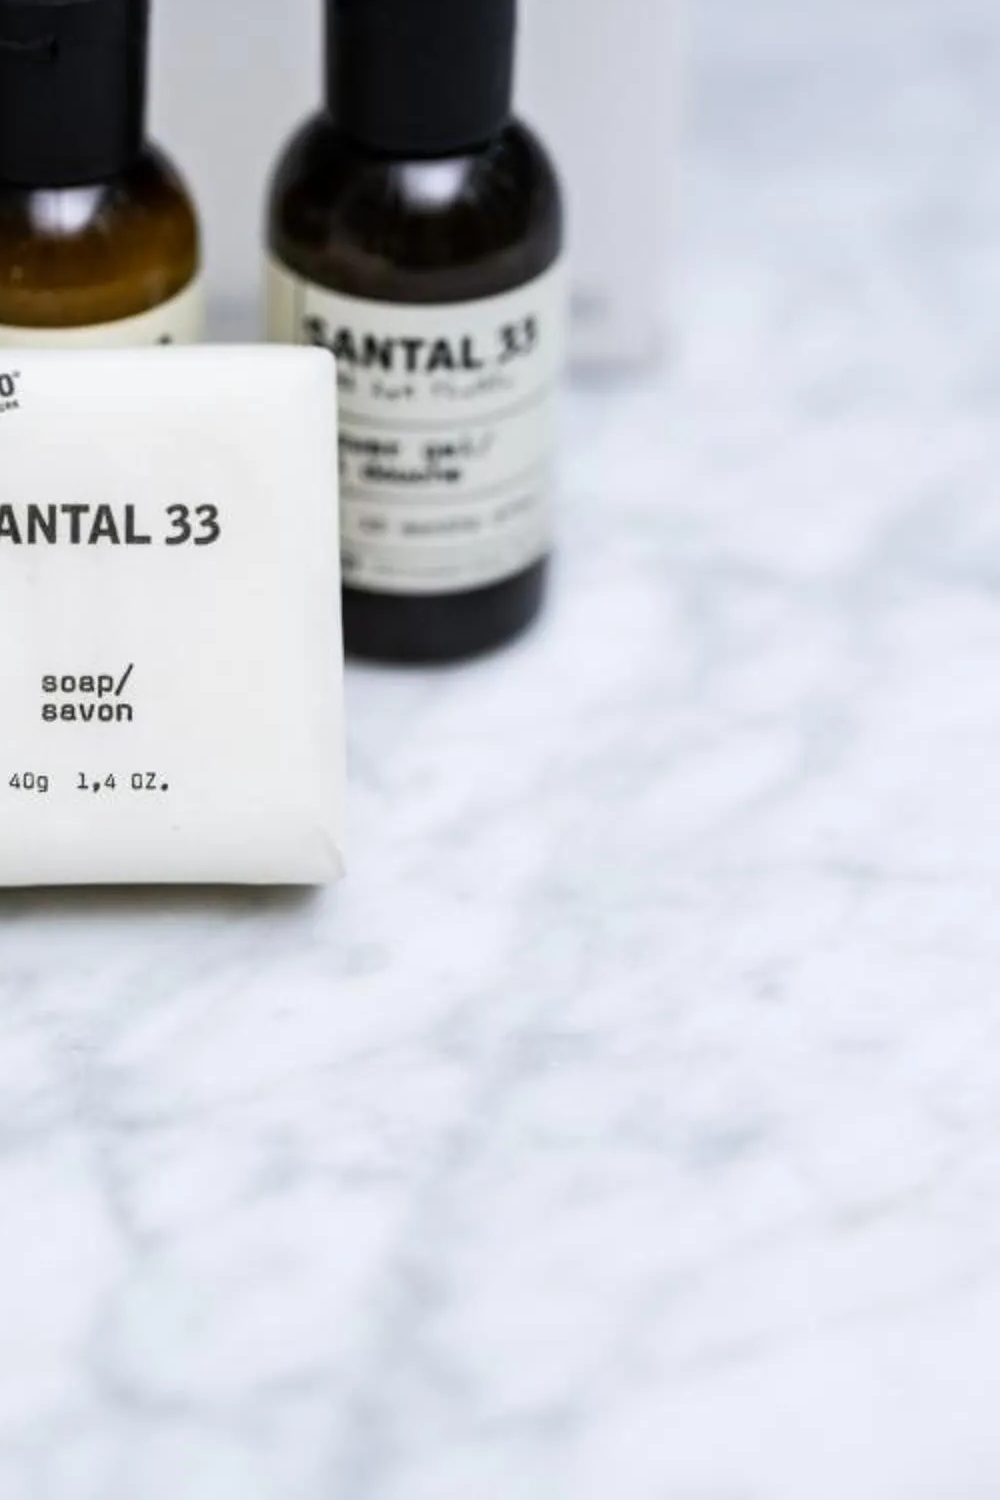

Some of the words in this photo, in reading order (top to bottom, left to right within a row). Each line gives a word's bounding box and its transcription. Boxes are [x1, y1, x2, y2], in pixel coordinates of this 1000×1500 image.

[164, 503, 222, 546] 33
[41, 662, 135, 699] soap/
[41, 703, 134, 722] savon
[8, 771, 50, 793] 40g
[76, 771, 117, 793] 1,4
[130, 771, 170, 793] OZ.
